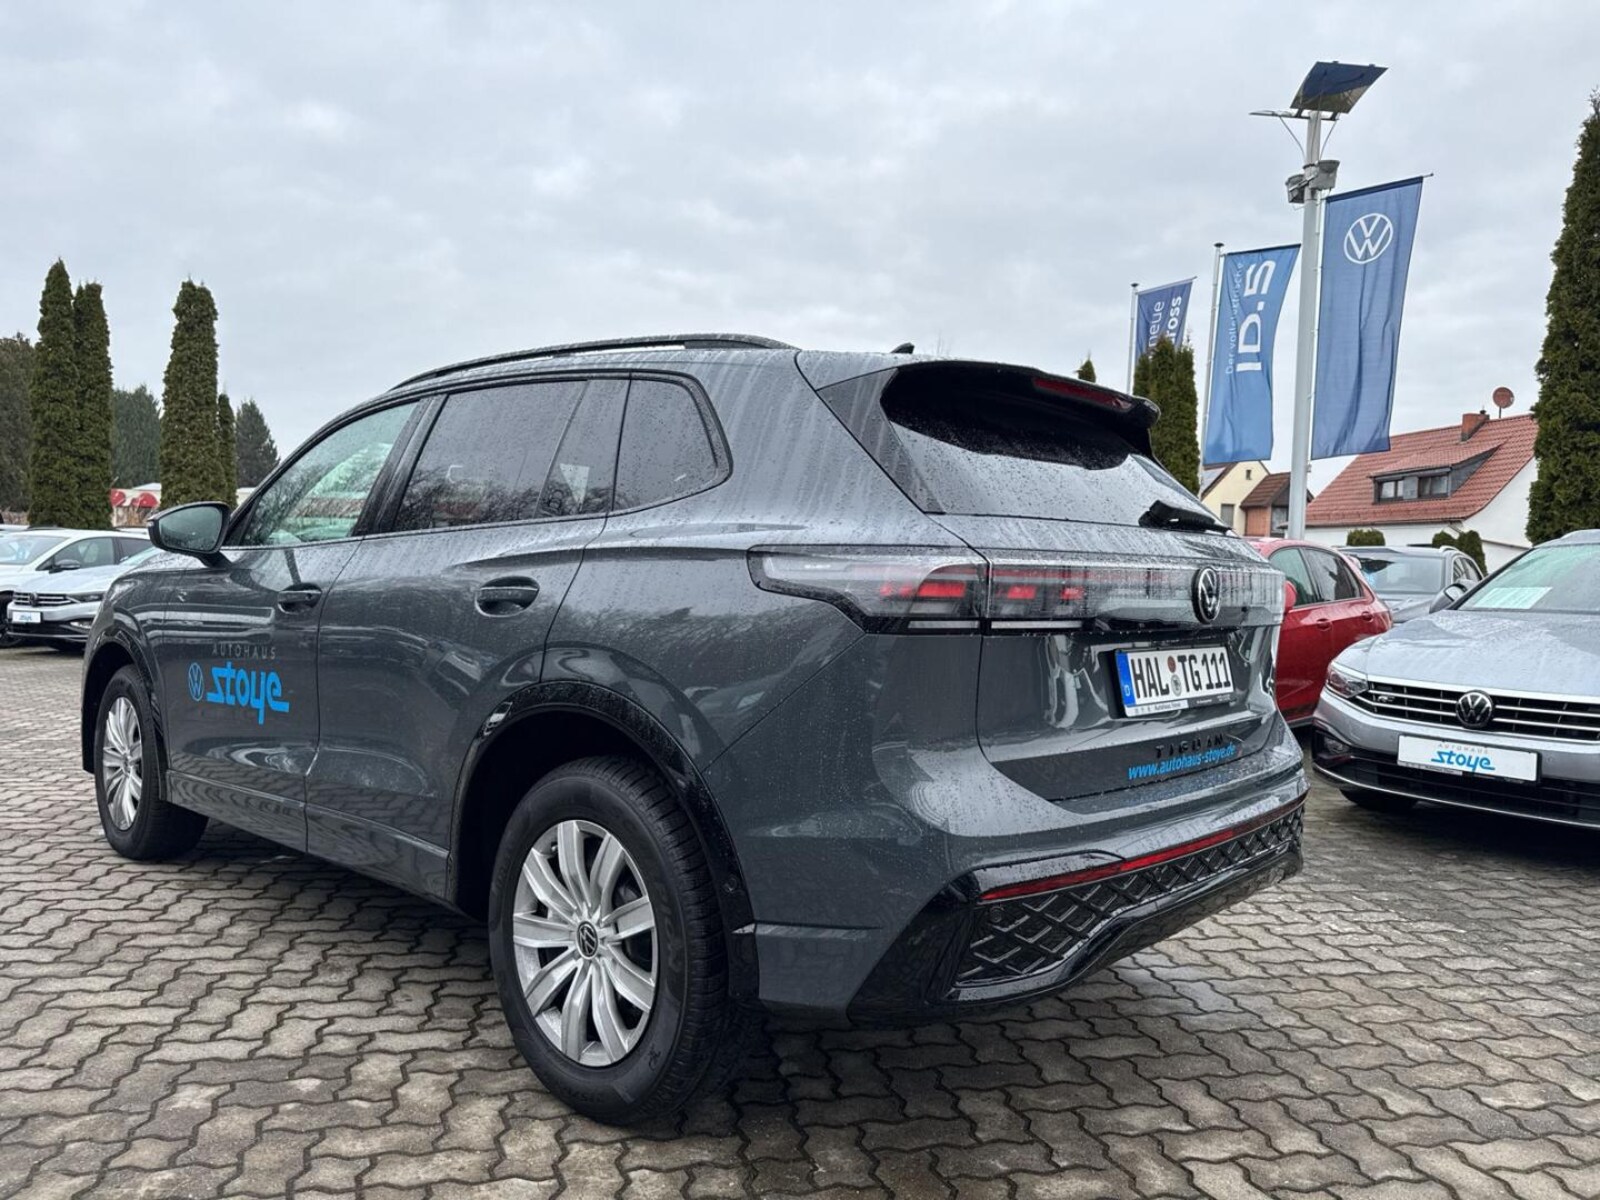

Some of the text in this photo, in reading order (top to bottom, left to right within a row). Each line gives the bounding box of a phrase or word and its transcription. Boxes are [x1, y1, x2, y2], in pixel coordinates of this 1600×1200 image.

[1148, 301, 1165, 348] neue
[1236, 260, 1276, 372] ID.5
[1225, 354, 1235, 375] Der
[211, 643, 276, 660] AUTOHAUS
[206, 661, 290, 725] stoye
[1130, 651, 1231, 699] HAL TG 111
[1128, 741, 1237, 780] www.autohaus-stoye.de
[1430, 750, 1496, 773] stoye
[1437, 743, 1488, 755] AUTOHAUS
